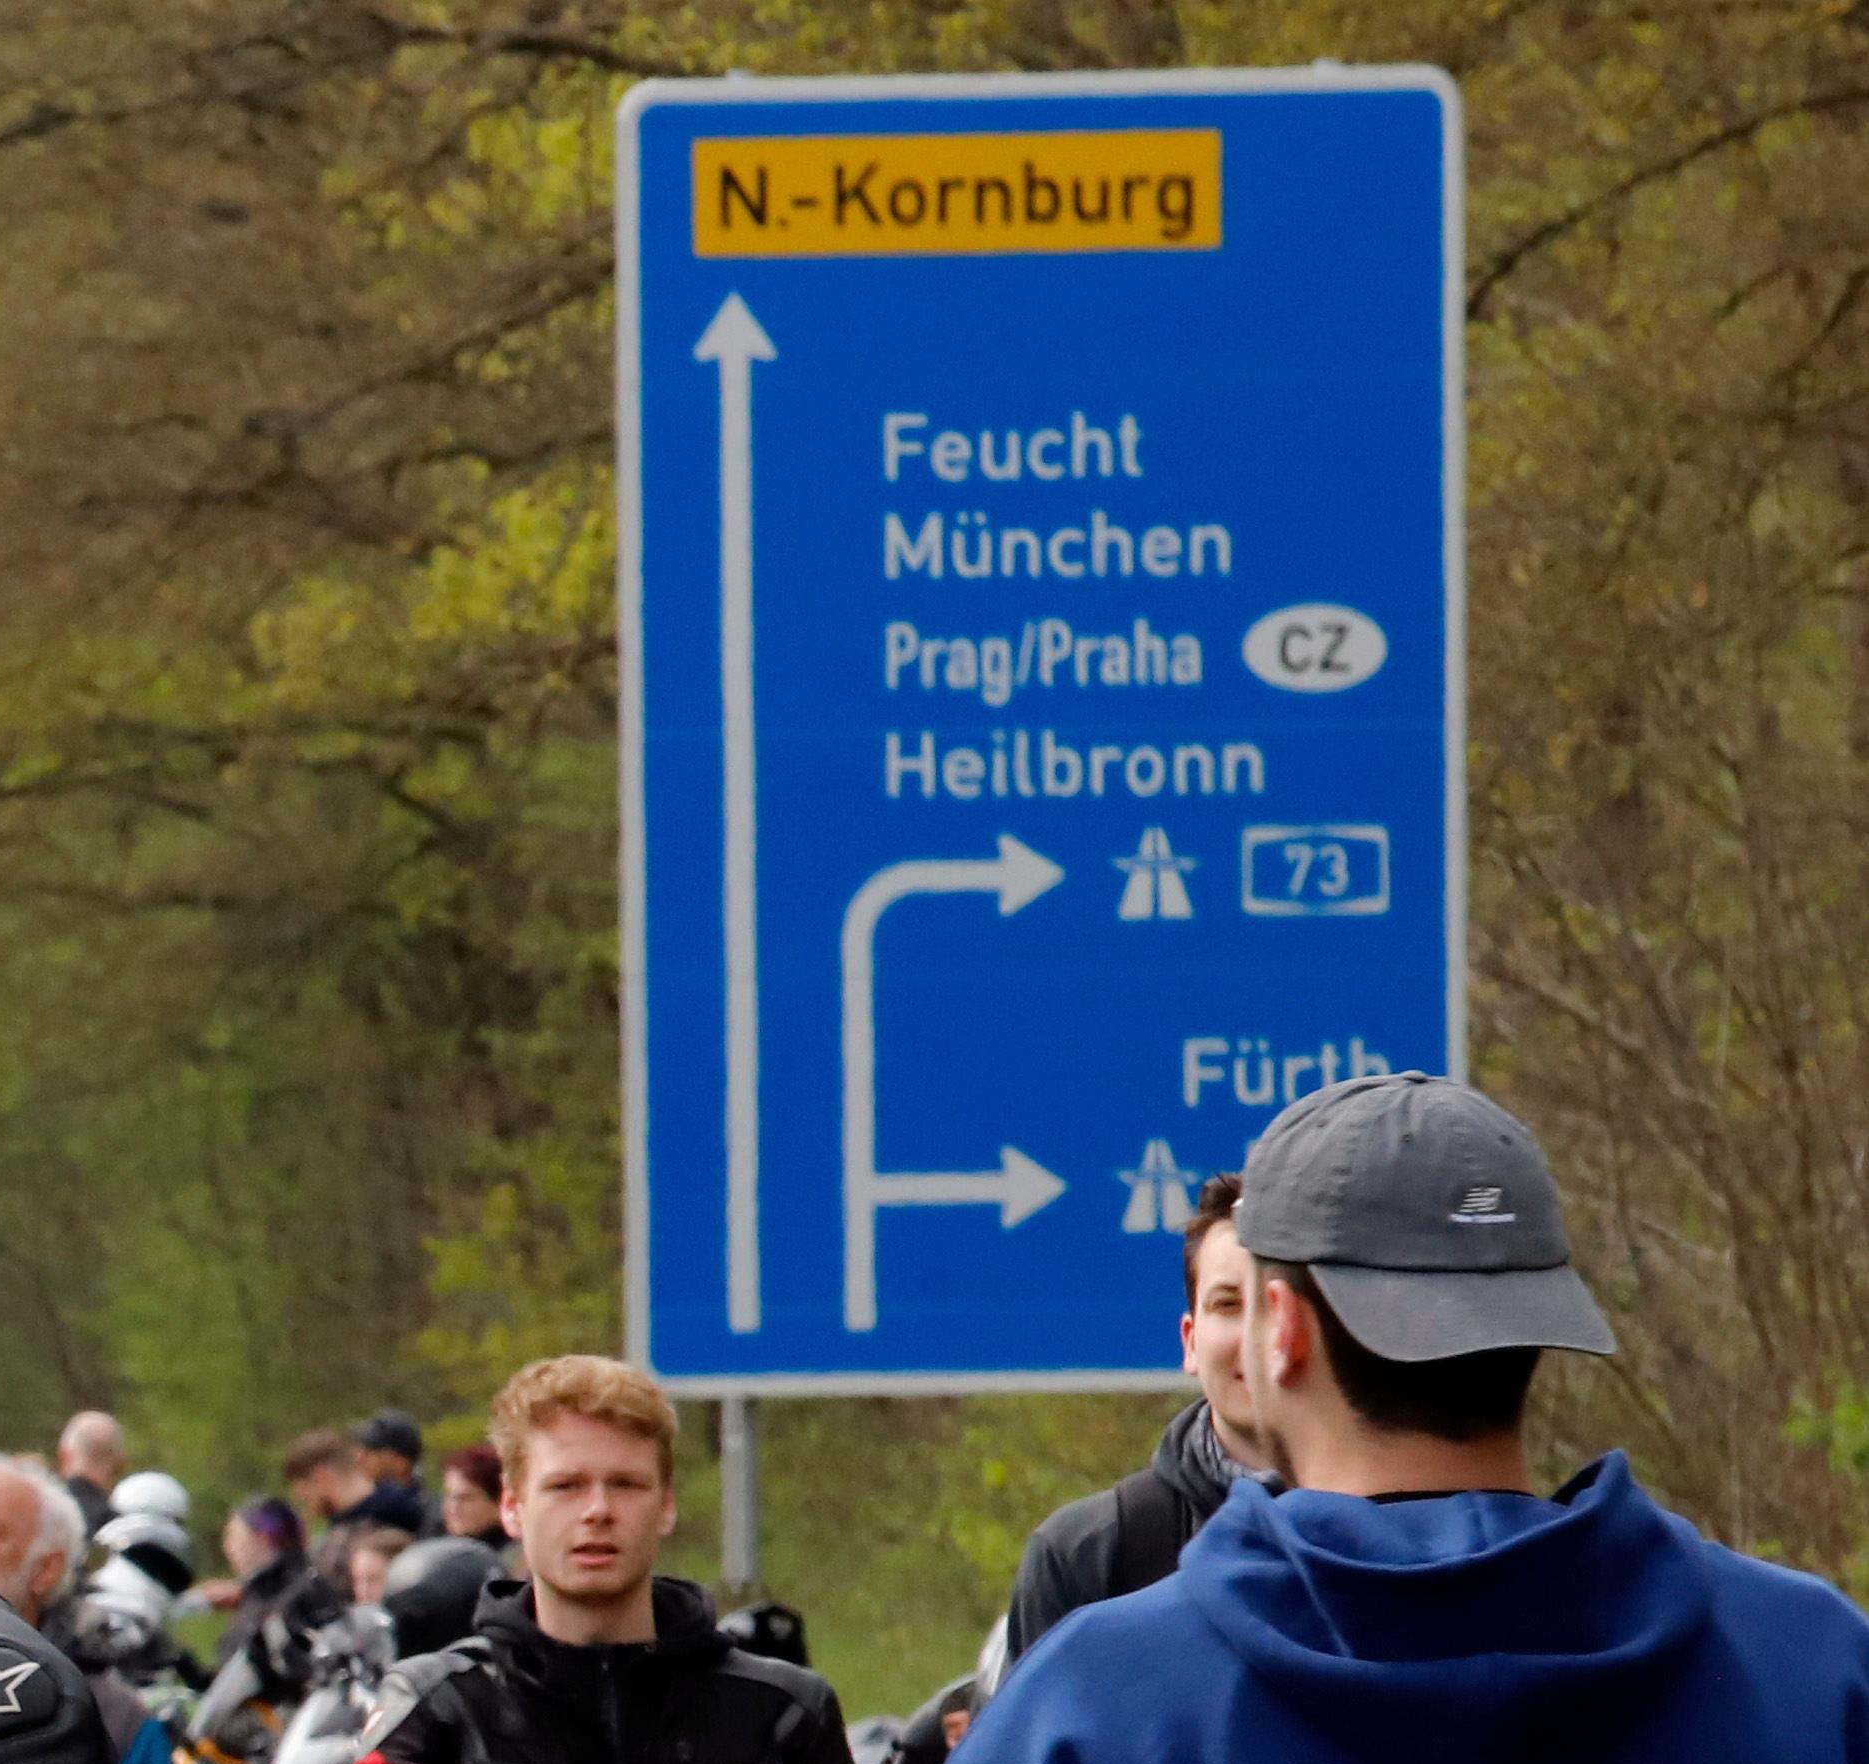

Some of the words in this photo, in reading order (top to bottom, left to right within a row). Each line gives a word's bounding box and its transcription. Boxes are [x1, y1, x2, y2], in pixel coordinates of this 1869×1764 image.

[718, 161, 1195, 241] N.-Kornburg
[883, 411, 1143, 482] Feucht
[883, 510, 1232, 580] München
[885, 618, 1203, 707] Prag/Praha
[1278, 624, 1349, 674] CZ
[885, 729, 1264, 799] Heilbronn
[1284, 844, 1350, 896] 73
